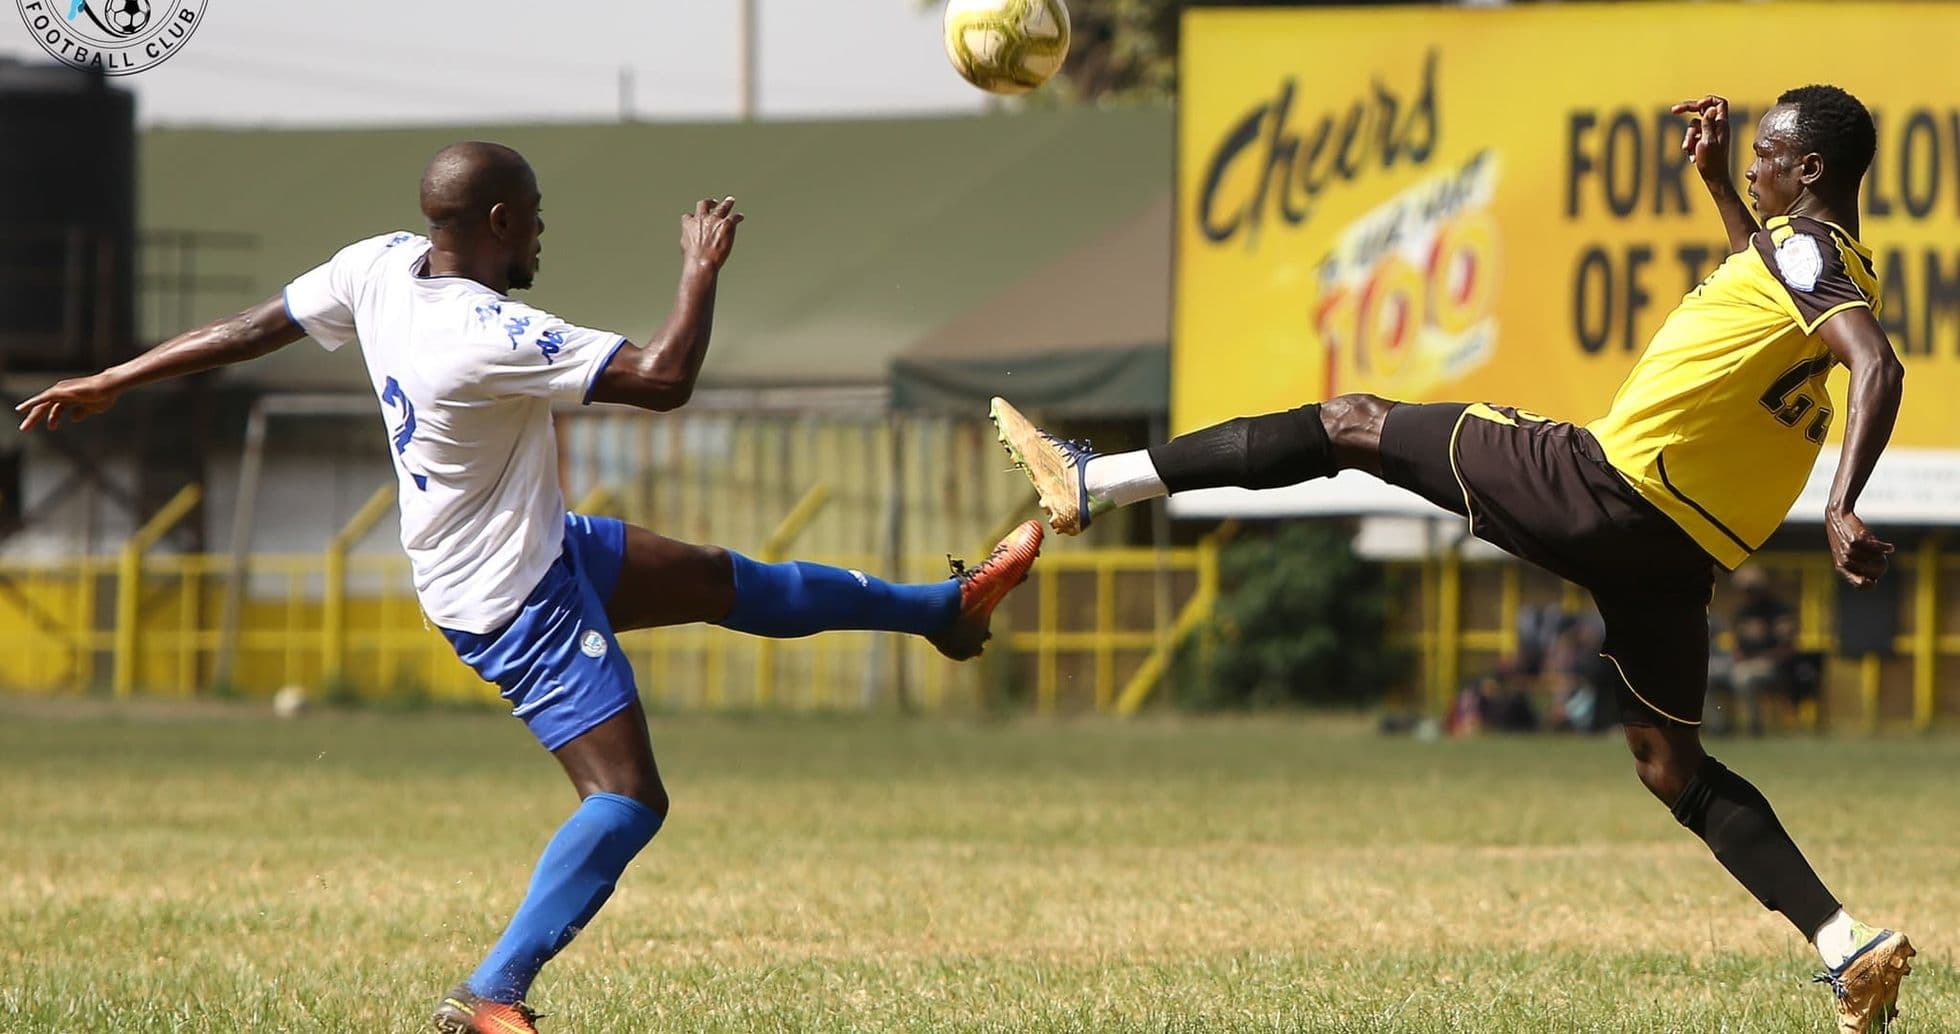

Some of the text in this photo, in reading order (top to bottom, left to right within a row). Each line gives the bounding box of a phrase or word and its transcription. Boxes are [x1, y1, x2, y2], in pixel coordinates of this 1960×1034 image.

[1200, 45, 1441, 254] Cheers
[1567, 107, 1691, 219] FOR
[1865, 107, 1960, 220] LO
[1574, 245, 1652, 354] OF
